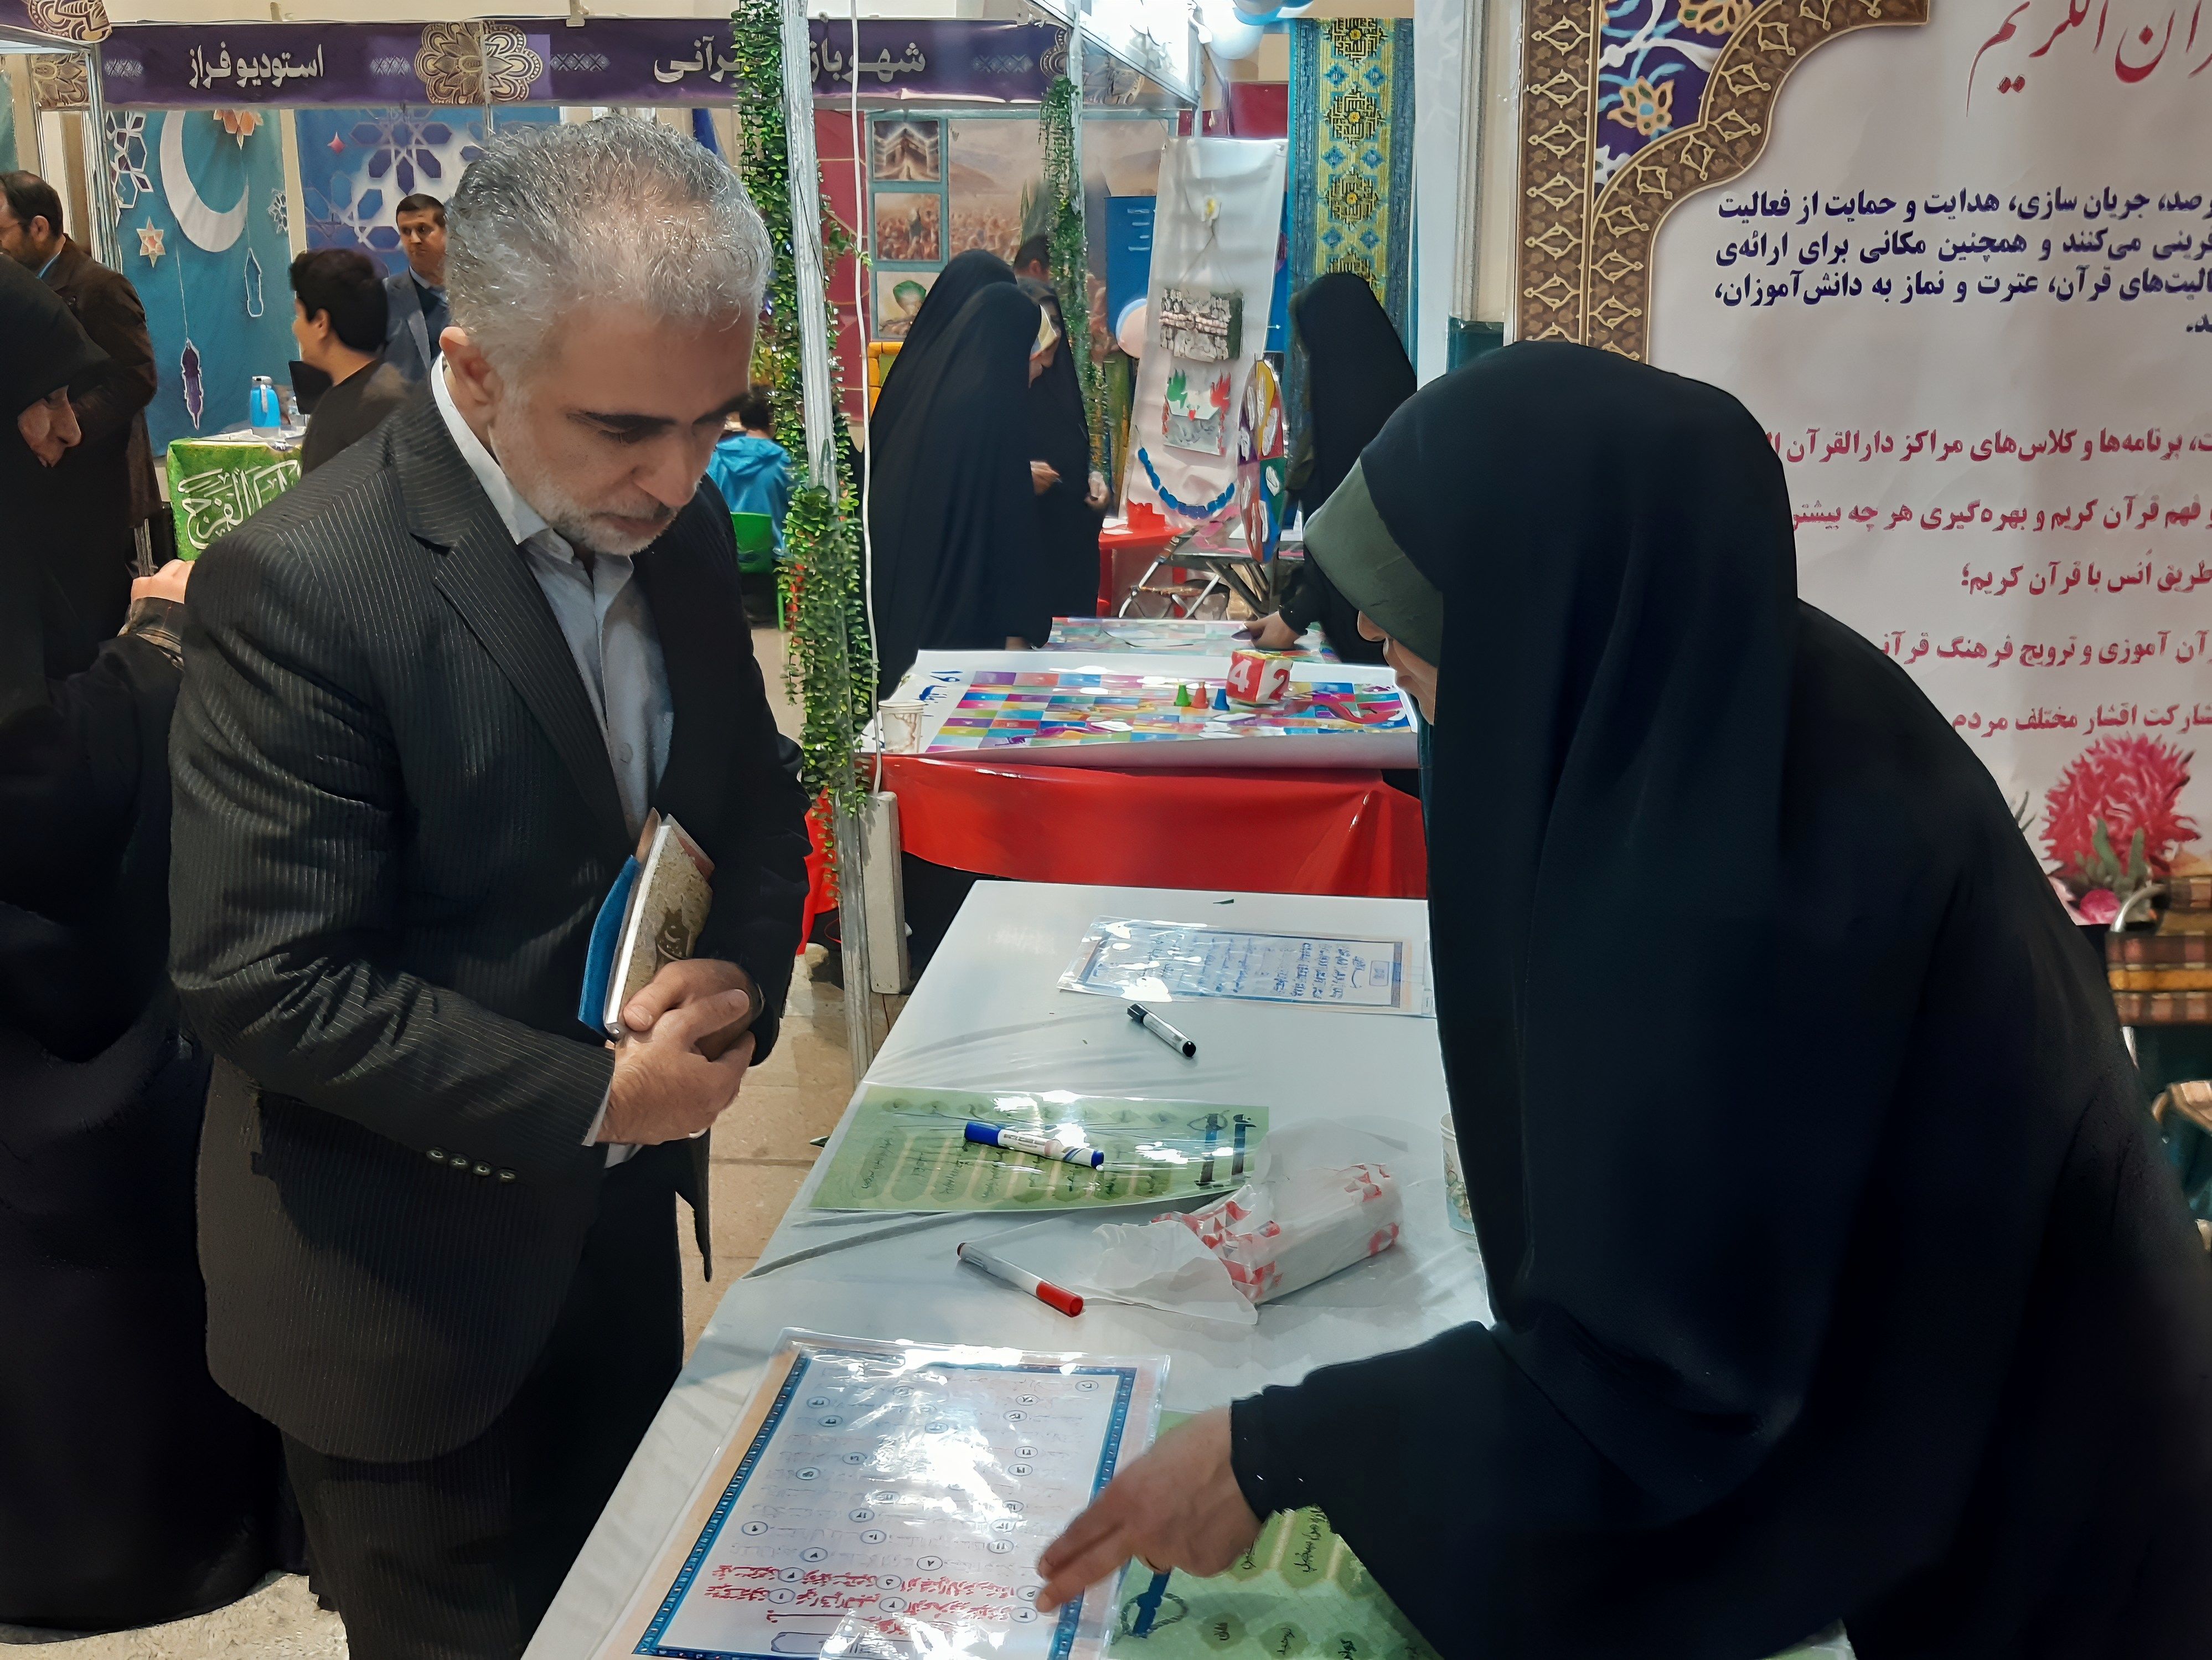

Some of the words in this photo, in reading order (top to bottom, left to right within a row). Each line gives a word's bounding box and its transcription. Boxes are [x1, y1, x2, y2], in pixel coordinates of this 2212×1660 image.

[189, 41, 231, 89] فراز
[237, 44, 323, 87] استودیو
[1718, 189, 1791, 224] فعالیت
[1795, 190, 1819, 225] از
[1825, 189, 1897, 223] حمایت
[1903, 200, 1917, 223] و
[1924, 187, 2000, 220] هدایت
[2009, 185, 2077, 220] سازی،
[2084, 185, 2151, 221] جریان
[1798, 230, 1849, 265] برای
[1860, 229, 1927, 264] مکانی
[1938, 232, 2027, 262] همچنین
[2038, 238, 2051, 261] و
[1872, 277, 1893, 303] به
[1900, 270, 1945, 304] نماز
[1952, 281, 1967, 303] و
[1977, 272, 2039, 303] عترت
[2049, 264, 2112, 303] قرآن،
[1899, 429, 1963, 462] مراکز
[2080, 440, 2093, 461] و
[1848, 504, 1879, 532] چه
[1883, 504, 1914, 531] هر
[2033, 510, 2046, 532] و
[2050, 498, 2100, 532] کریم
[2103, 494, 2160, 530] قرآن
[2164, 494, 2201, 529] فهم
[1962, 564, 2024, 596] کریم؛
[2029, 560, 2082, 596] قرآن
[2087, 563, 2102, 594] با
[1935, 633, 2015, 669] فرهنگ
[2019, 638, 2076, 669] ترویج
[2081, 645, 2092, 666] و
[2098, 630, 2172, 666] آموزی
[1228, 658, 1253, 693] 4
[1268, 668, 1291, 701] 2
[1951, 711, 2009, 739] مردم
[2014, 704, 2079, 733] مختلف
[2084, 702, 2138, 736] اقشار
